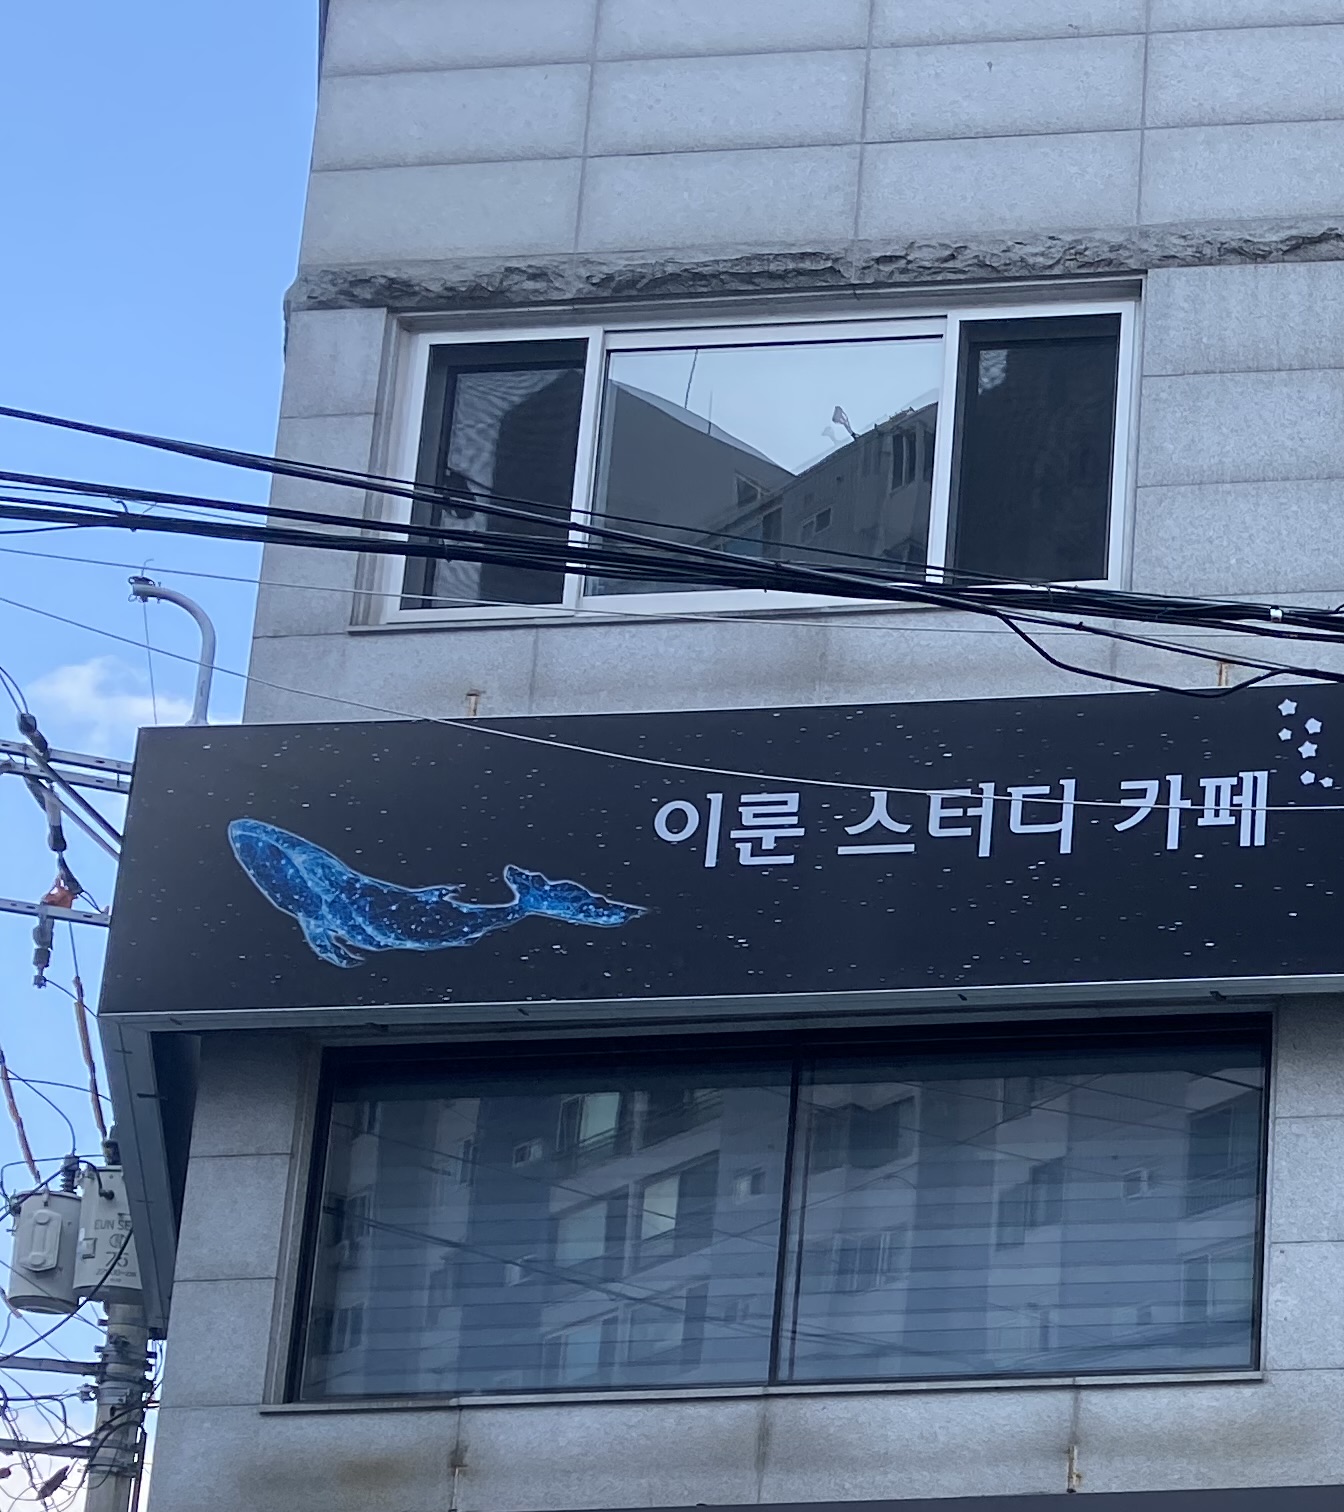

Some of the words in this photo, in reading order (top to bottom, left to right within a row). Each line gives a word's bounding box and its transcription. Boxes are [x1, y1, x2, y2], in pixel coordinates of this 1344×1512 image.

[654, 790, 805, 869] 이룬
[837, 775, 1075, 857] 스터디
[1116, 769, 1269, 850] 카페
